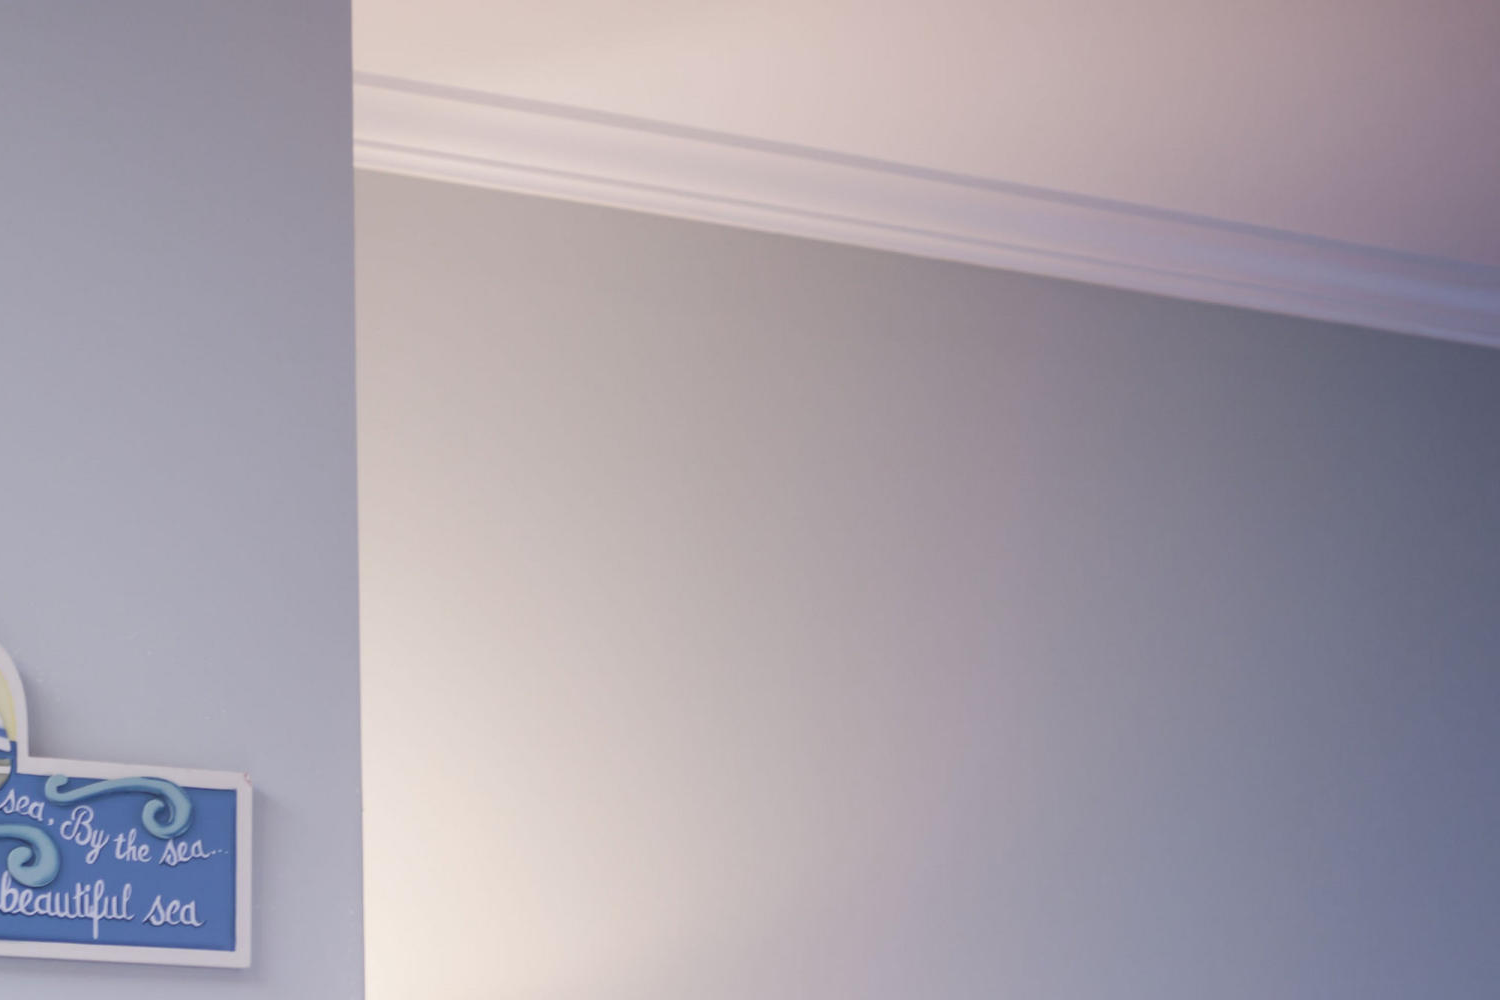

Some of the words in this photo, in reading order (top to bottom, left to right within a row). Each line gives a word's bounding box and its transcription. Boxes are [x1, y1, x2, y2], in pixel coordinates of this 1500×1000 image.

[60, 806, 109, 864] By
[114, 829, 152, 863] the
[143, 895, 203, 926] sea
